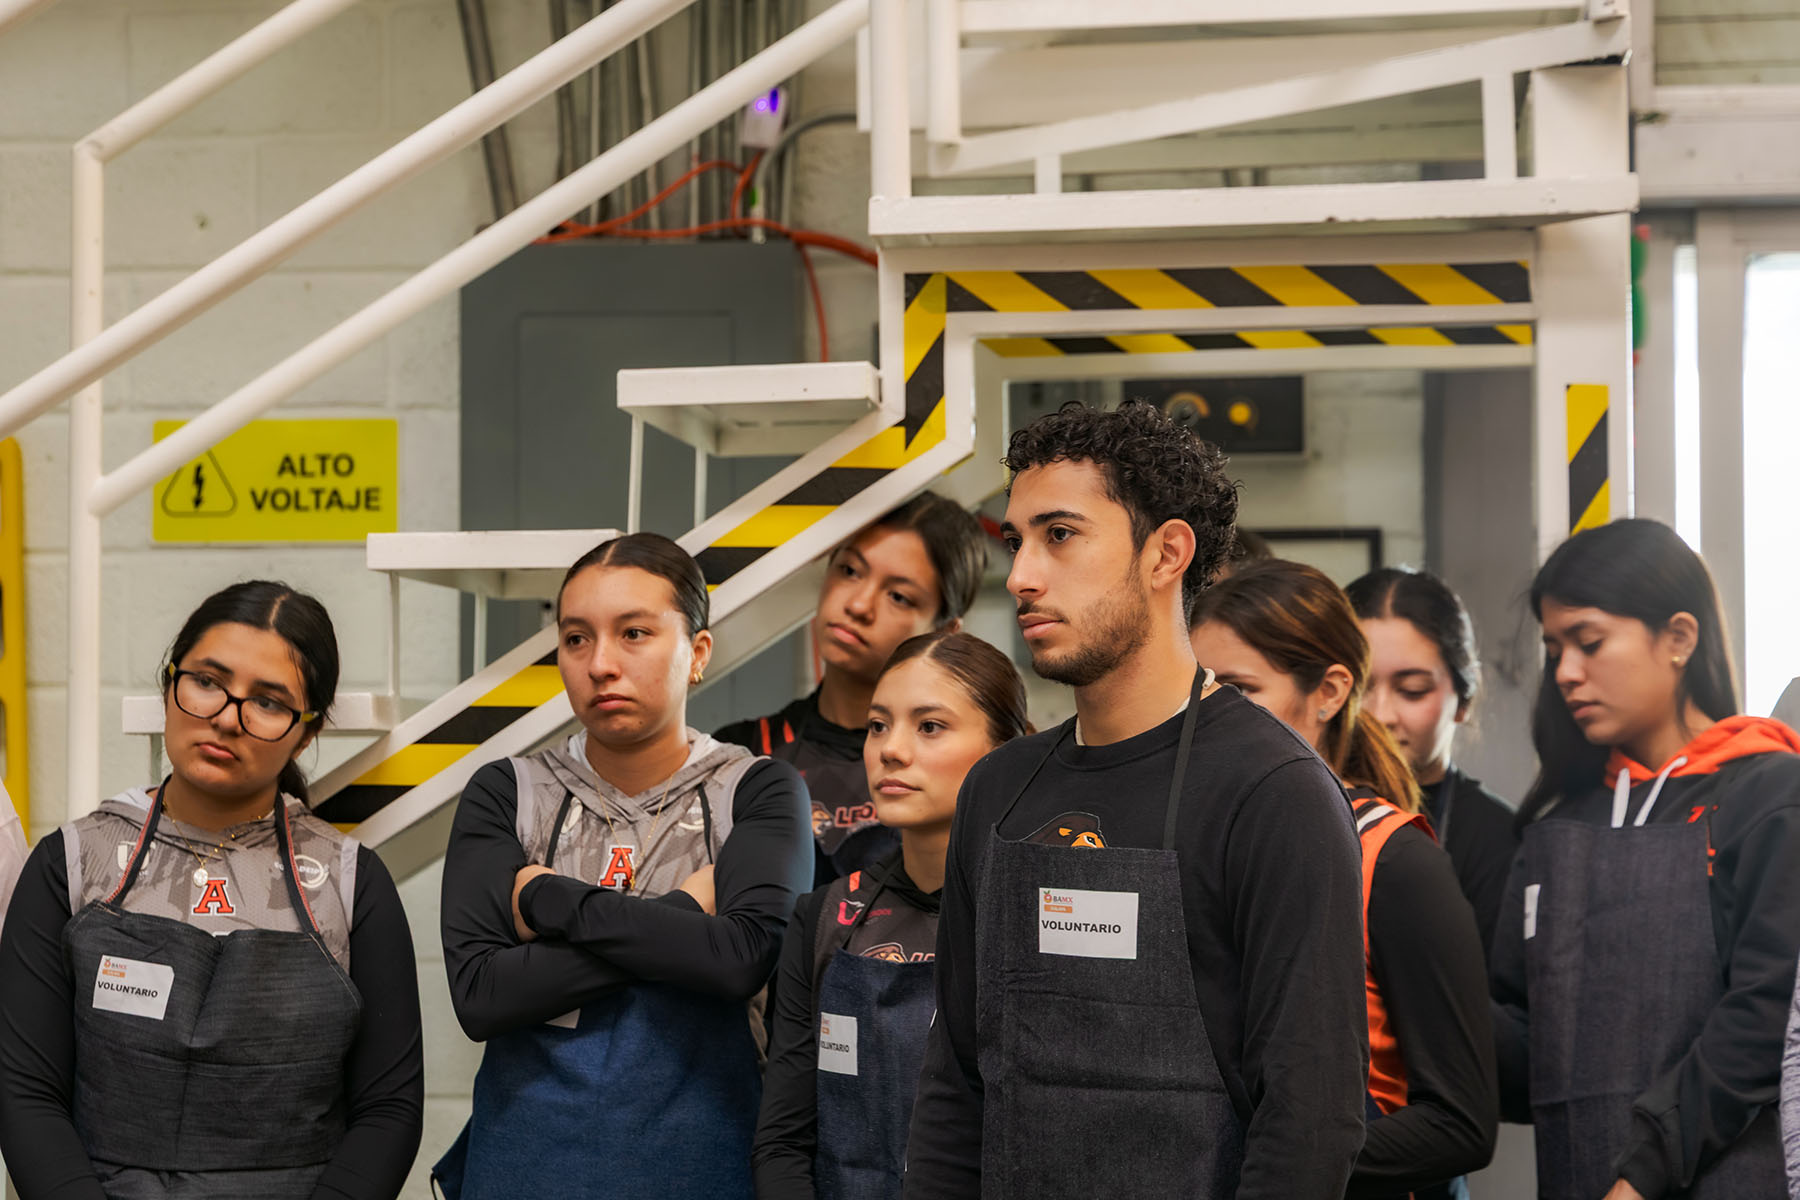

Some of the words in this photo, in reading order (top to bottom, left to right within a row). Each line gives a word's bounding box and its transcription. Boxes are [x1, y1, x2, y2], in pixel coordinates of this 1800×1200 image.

[277, 454, 355, 478] ALTO
[250, 487, 381, 512] VOLTAJE
[835, 802, 879, 828] LEO
[600, 846, 637, 887] A
[192, 878, 236, 915] A
[1041, 919, 1121, 934] VOLUNTARIO
[97, 981, 158, 998] VOLUNTARIO
[820, 1040, 850, 1053] OLUNTARIO
